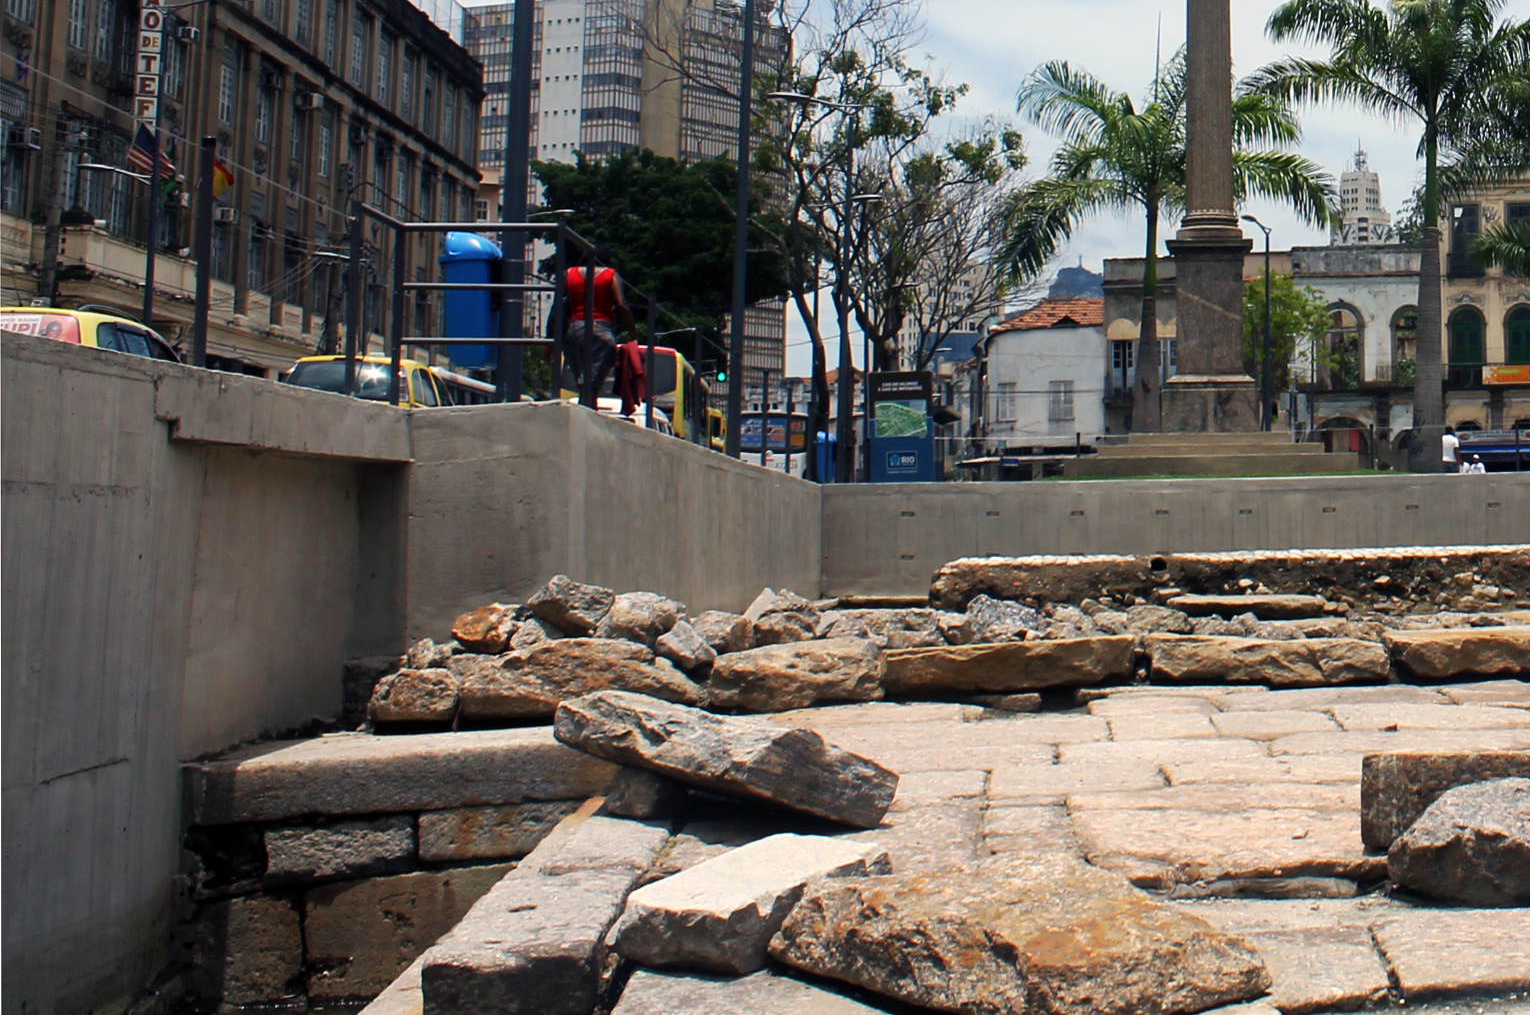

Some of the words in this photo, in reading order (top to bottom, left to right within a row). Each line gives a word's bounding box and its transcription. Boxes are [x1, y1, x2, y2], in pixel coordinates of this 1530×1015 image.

[142, 35, 159, 49] DE
[136, 55, 157, 127] TEF
[901, 456, 915, 464] RIO
